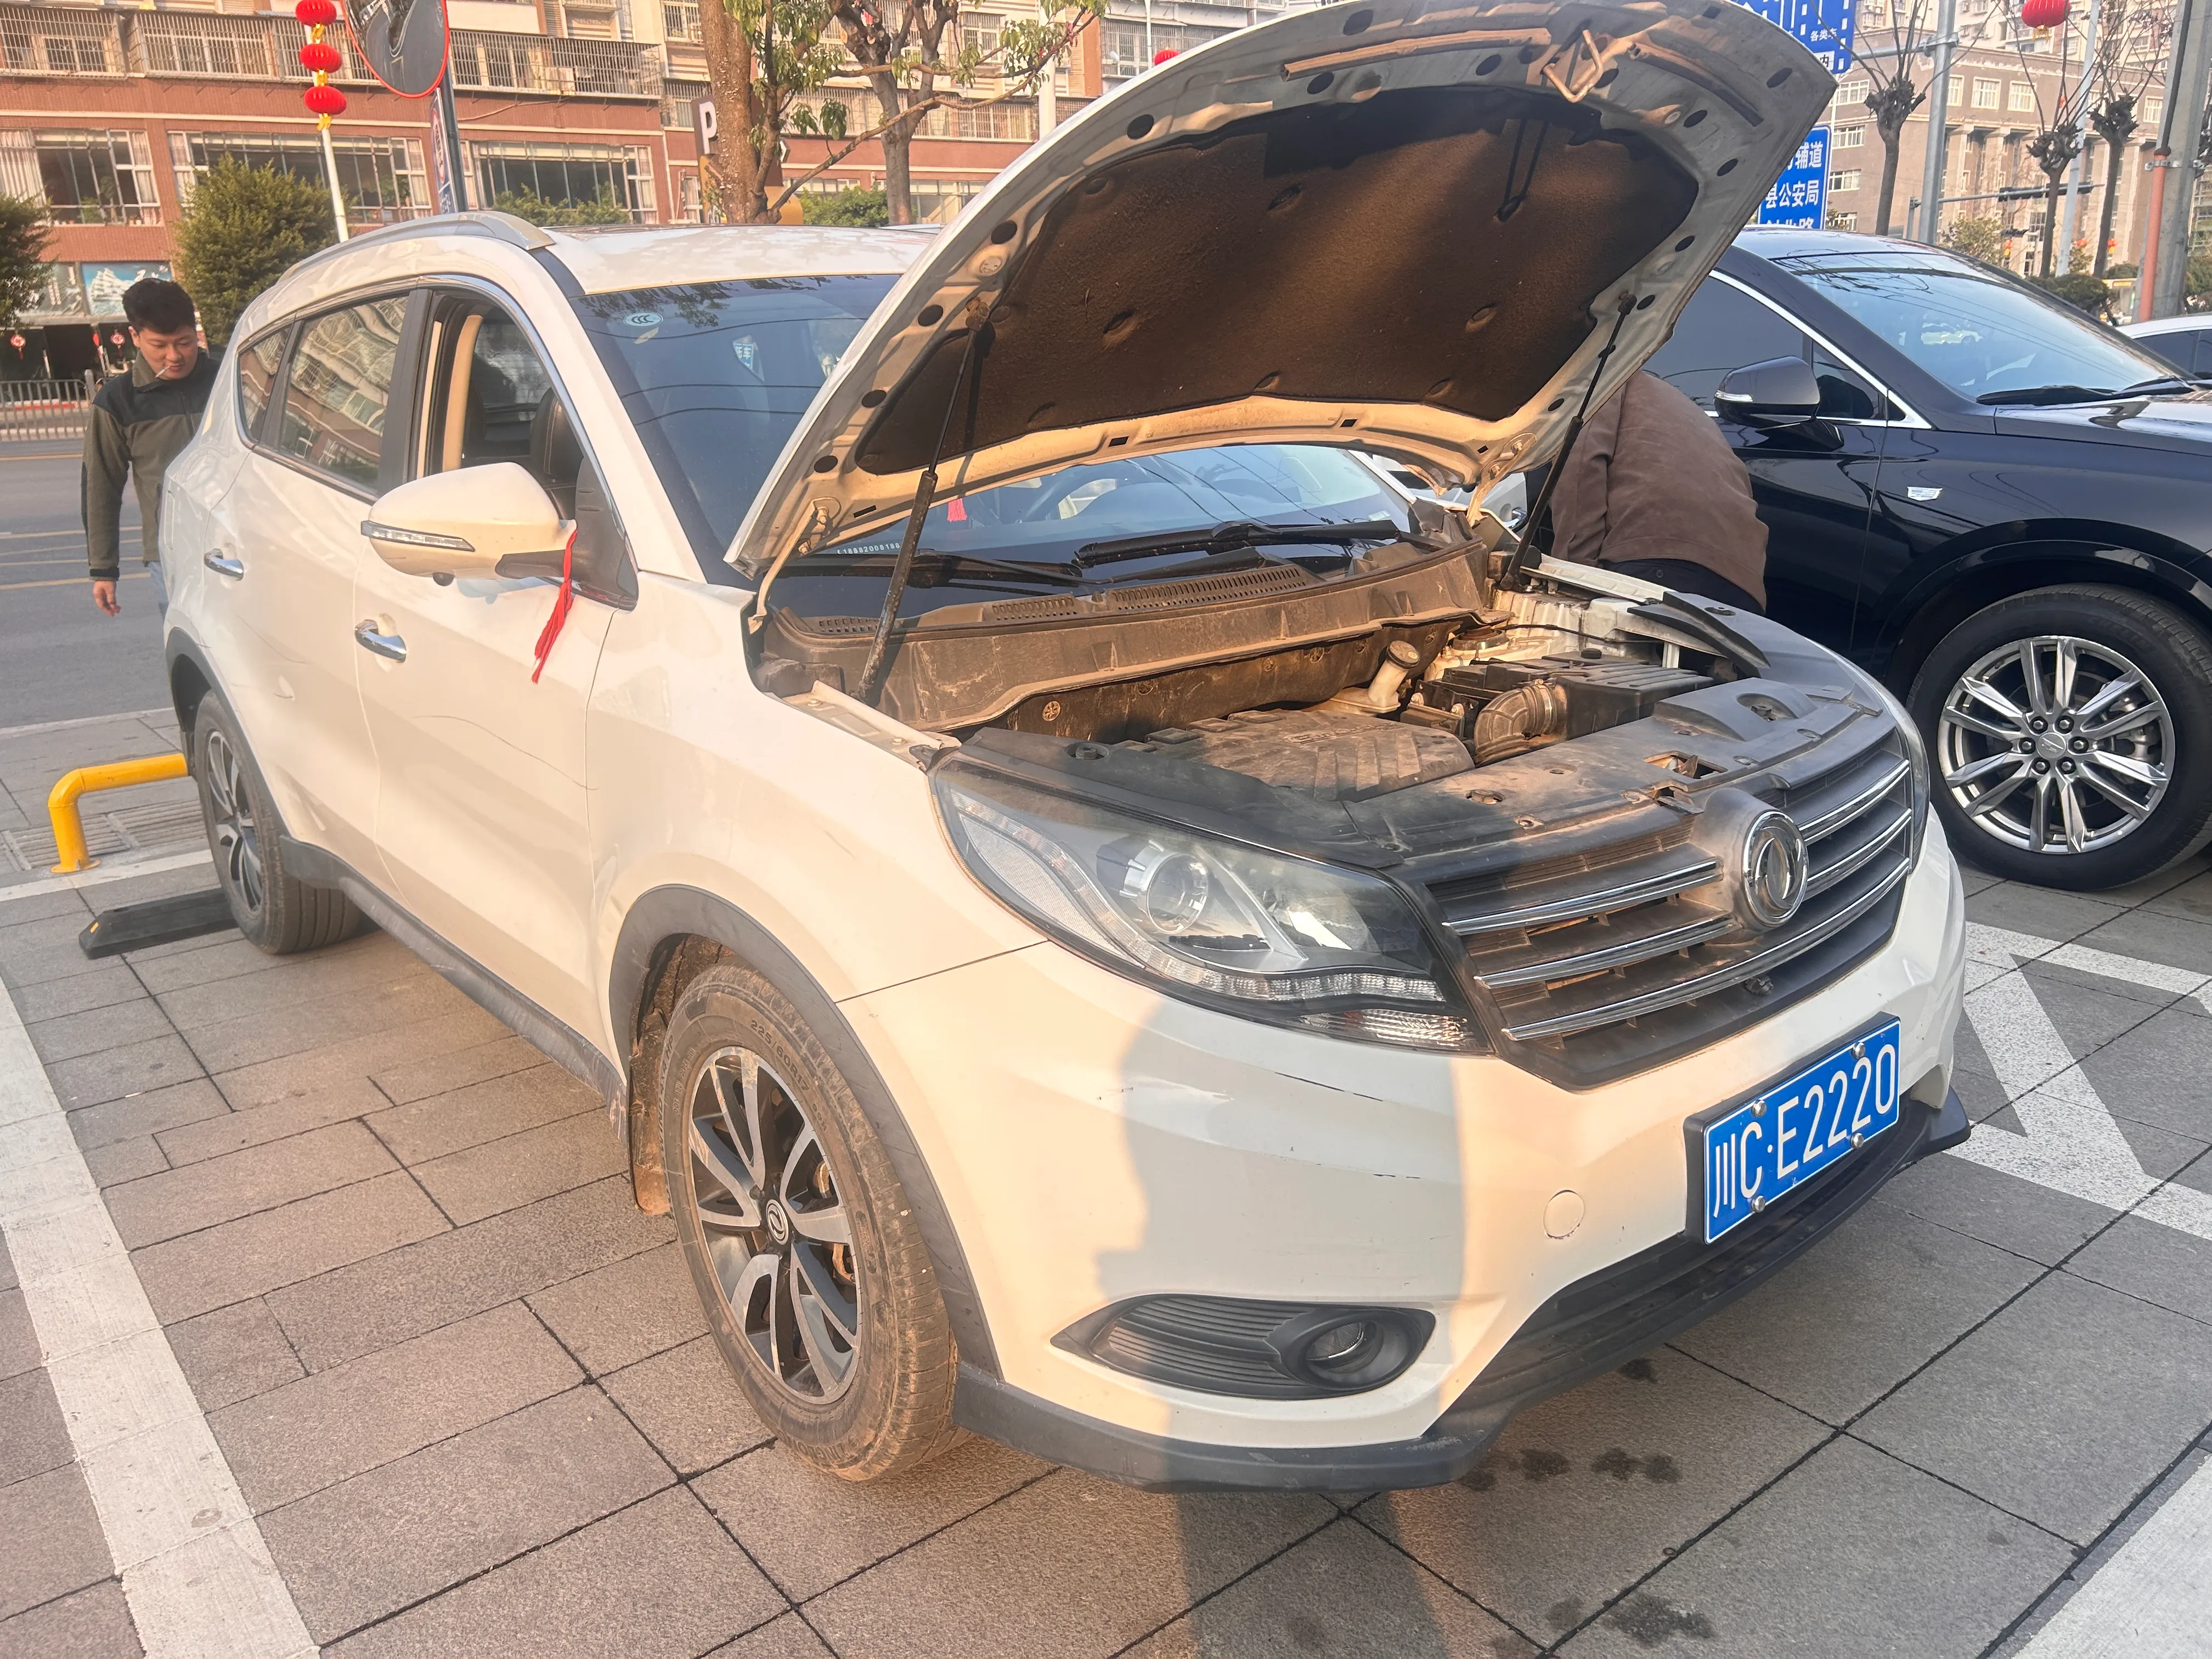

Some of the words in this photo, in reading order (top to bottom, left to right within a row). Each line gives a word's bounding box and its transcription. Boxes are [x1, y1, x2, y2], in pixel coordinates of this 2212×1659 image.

[1810, 28, 1837, 42] 各类车
[699, 101, 717, 154] P
[1787, 141, 1823, 170] 辅道
[1765, 180, 1819, 209] 县公安局
[631, 315, 654, 324] CCC
[751, 1019, 809, 1091] 225/60R17
[1713, 1043, 1895, 1218] 川C·E2220
